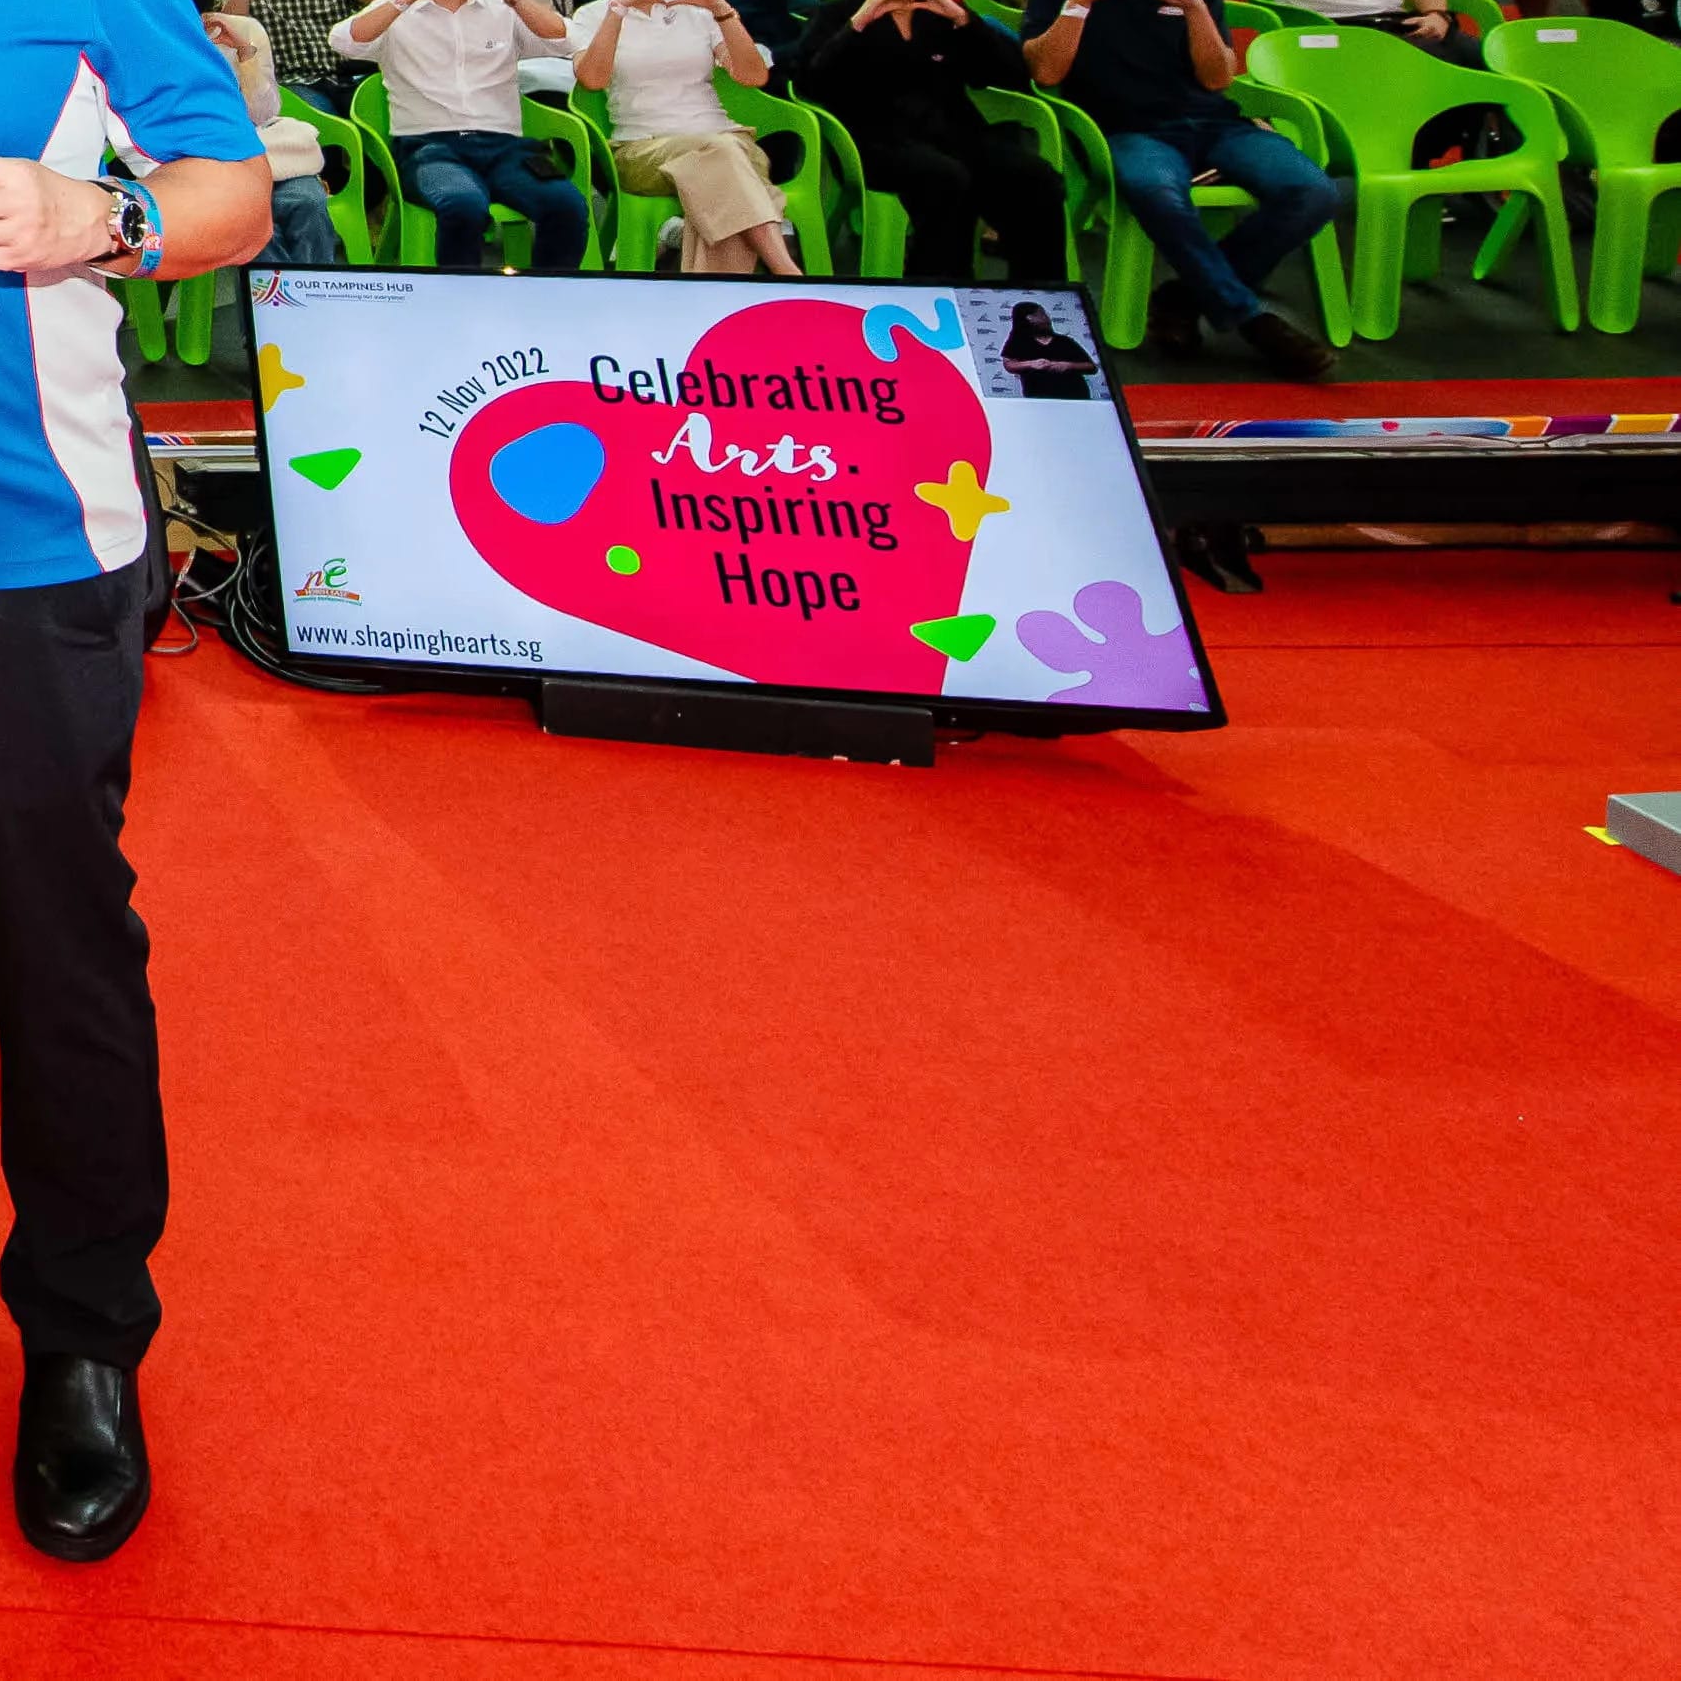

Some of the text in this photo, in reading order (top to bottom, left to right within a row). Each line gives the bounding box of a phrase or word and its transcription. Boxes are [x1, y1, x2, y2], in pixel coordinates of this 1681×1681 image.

[294, 280, 414, 292] OUR TAMPINES HUB
[419, 347, 549, 439] 12 Nov 2022
[590, 355, 905, 425] Celebrating
[650, 478, 898, 551] Inspiring
[714, 551, 861, 621] Hope
[297, 624, 543, 662] www.shapinghearts.sg
